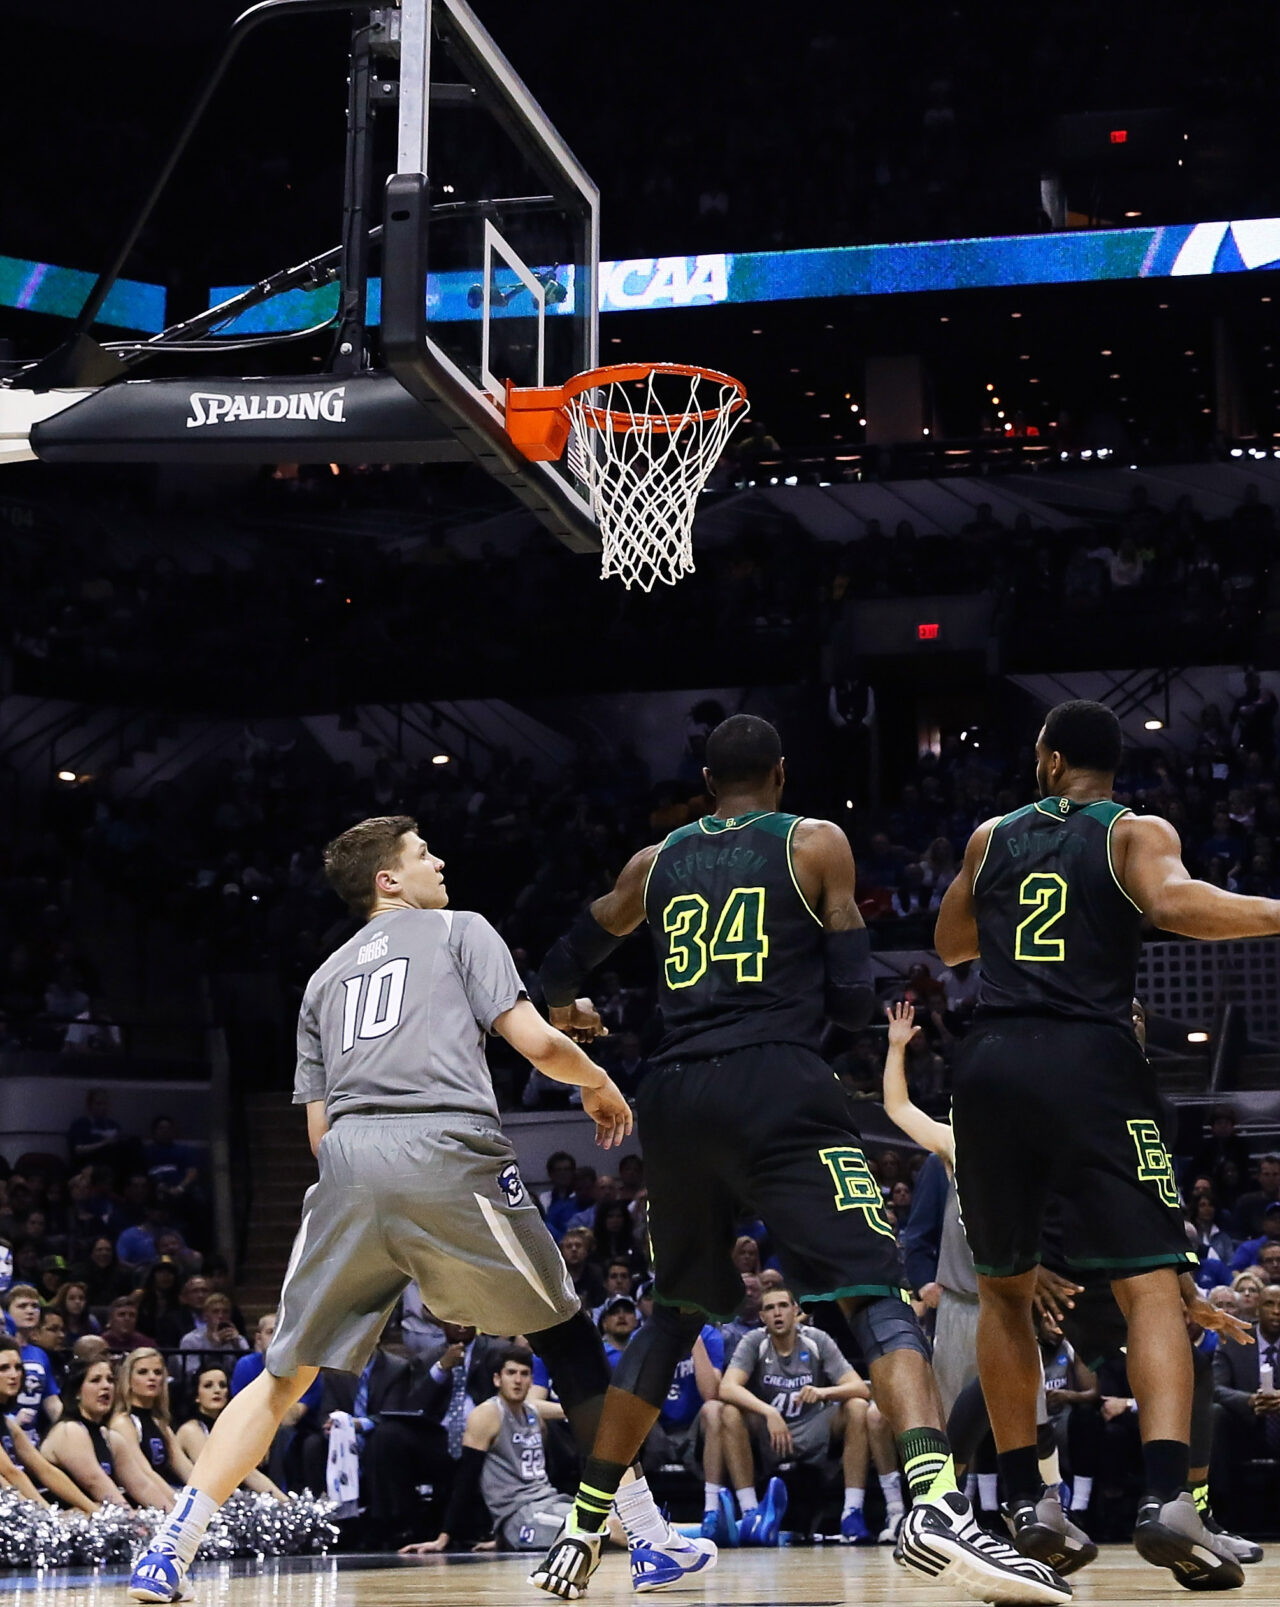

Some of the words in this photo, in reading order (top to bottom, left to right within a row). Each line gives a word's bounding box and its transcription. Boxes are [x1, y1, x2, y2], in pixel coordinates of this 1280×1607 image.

[186, 386, 346, 428] SPALDING
[357, 935, 389, 965] GIBBS
[663, 887, 769, 990] 34
[1015, 873, 1068, 961] 2
[341, 957, 410, 1055] 10
